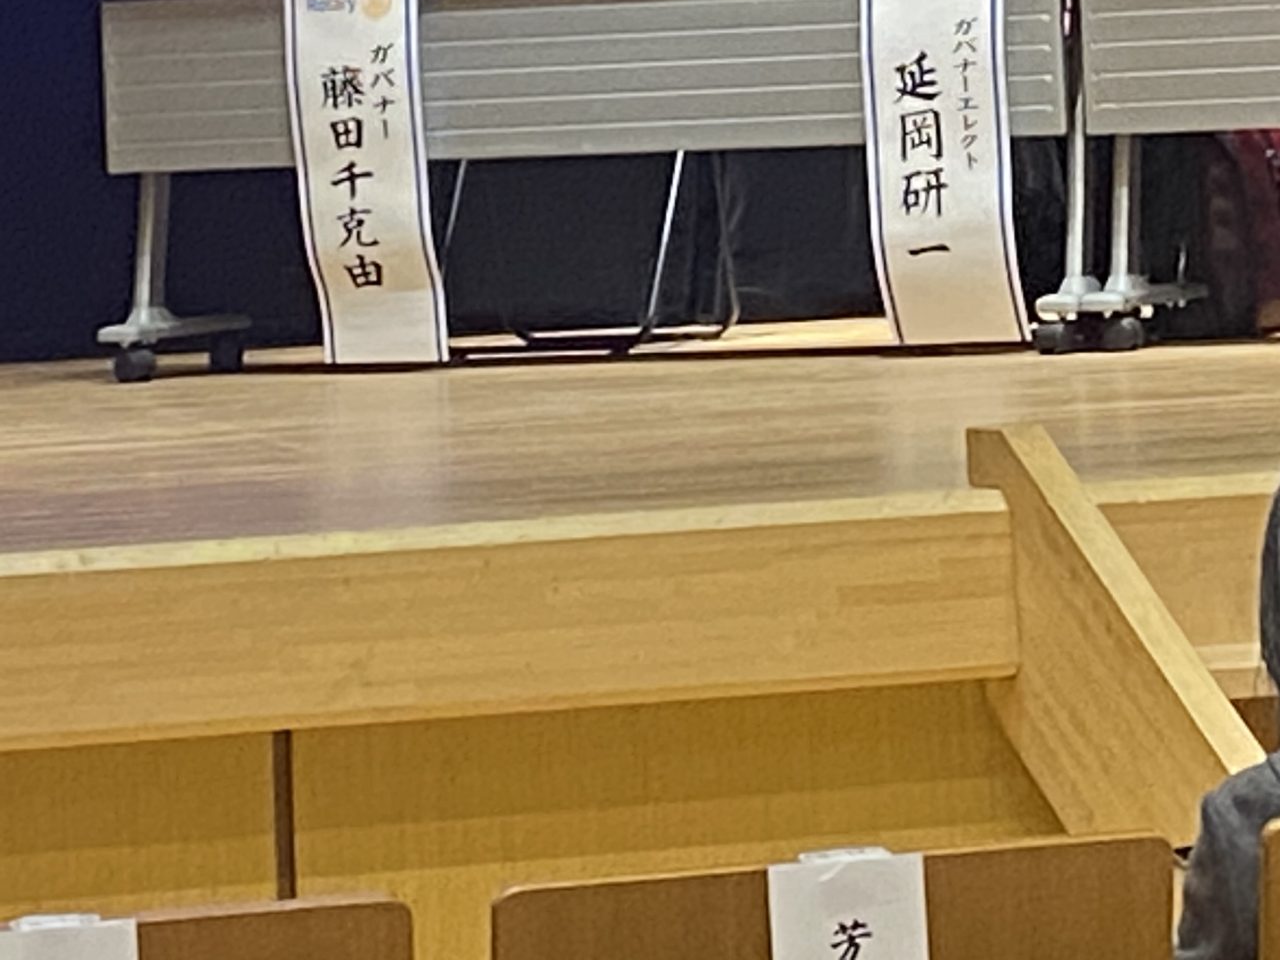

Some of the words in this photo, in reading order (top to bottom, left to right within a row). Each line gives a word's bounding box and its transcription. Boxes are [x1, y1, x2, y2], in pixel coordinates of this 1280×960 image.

[320, 65, 384, 289] 藤田千克由
[370, 42, 395, 141] ガバナー
[893, 49, 951, 258] 延岡研一
[952, 16, 979, 171] ガバナーエレクト
